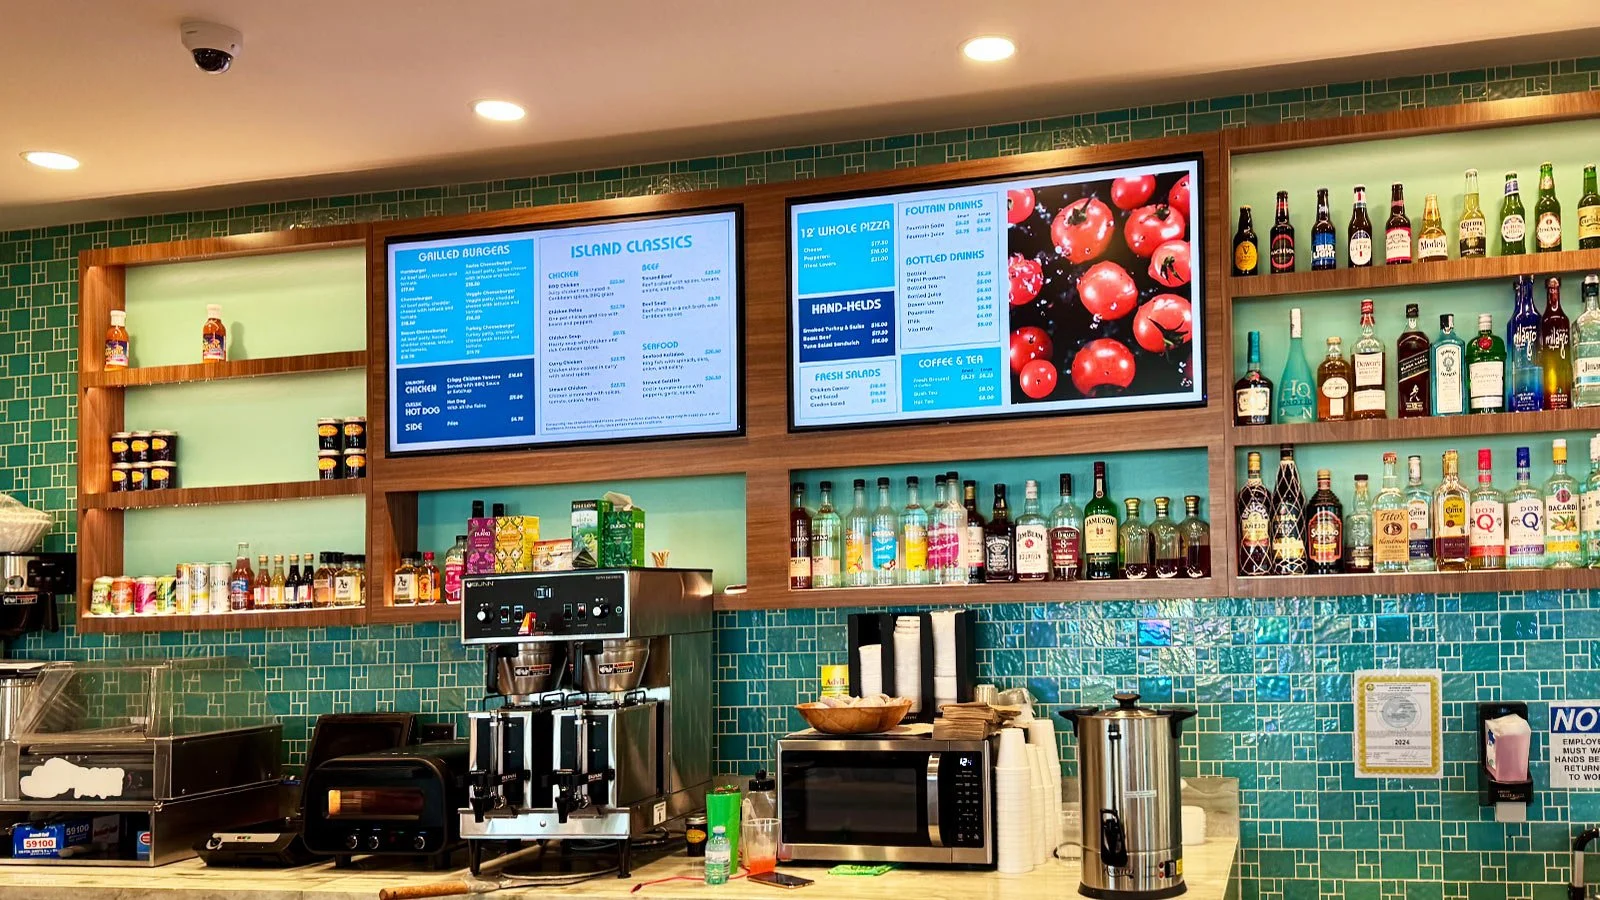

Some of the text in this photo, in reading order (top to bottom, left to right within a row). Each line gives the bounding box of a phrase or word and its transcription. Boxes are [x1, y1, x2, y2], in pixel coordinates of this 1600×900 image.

[905, 200, 983, 216] FOUTAIN DRINKS
[818, 223, 857, 236] WHOLE
[860, 220, 890, 232] PIZZA
[571, 235, 692, 258] ISLAND CLASSICS
[1315, 244, 1334, 252] BUD
[418, 245, 510, 262] GRILLED BURGERS
[906, 250, 984, 265] BOTTLED DRINKS
[1313, 251, 1336, 259] LIGHT
[641, 263, 660, 271] BEEF
[548, 270, 579, 280] CHICKEN
[811, 299, 882, 315] HAND-HELDS
[642, 341, 679, 351] SEAFOOD
[918, 355, 983, 368] COFFEE & TEA
[815, 368, 881, 381] FRESH SALADS
[405, 384, 437, 394] CHICKEN
[405, 406, 441, 416] HOT DOG
[405, 423, 423, 432] SIDE
[1086, 517, 1115, 527] JAMESON
[1380, 512, 1405, 521] Tito's
[1522, 512, 1539, 531] Q
[1476, 513, 1495, 533] Q
[1553, 708, 1600, 731] NO
[66, 824, 89, 836] 59100
[25, 839, 54, 848] 59100
